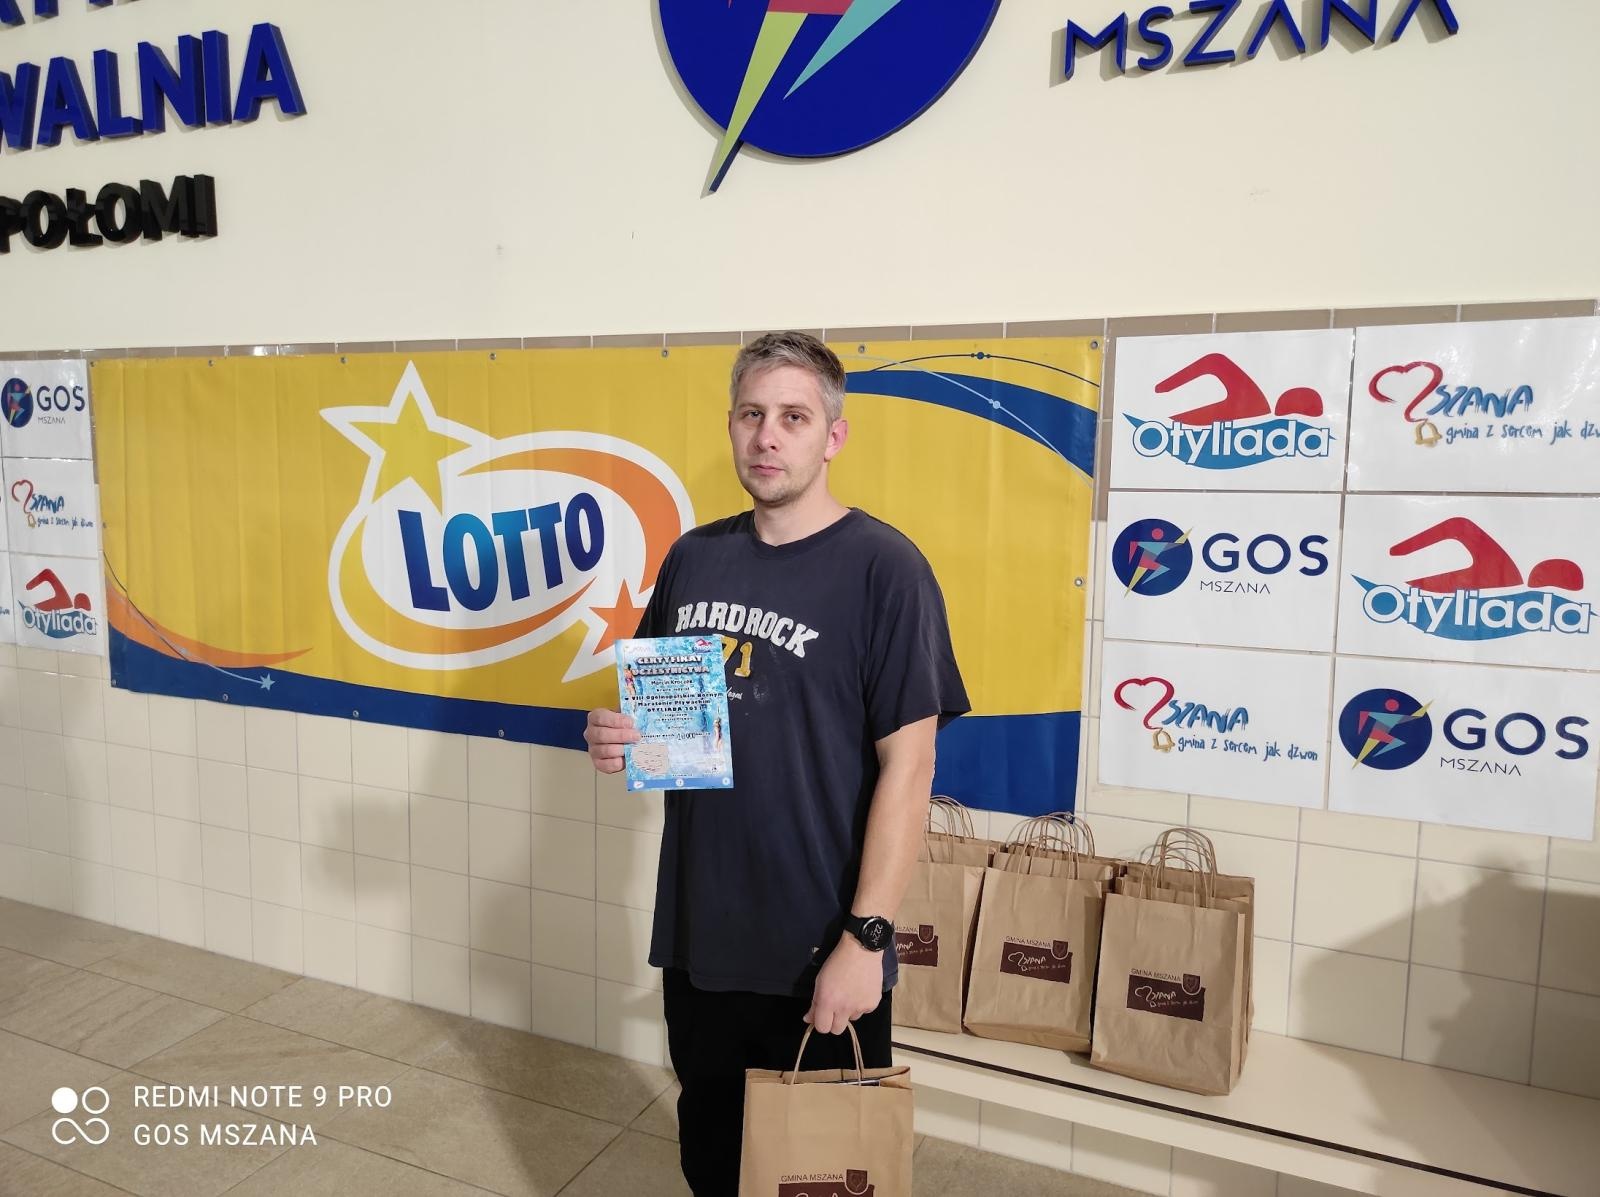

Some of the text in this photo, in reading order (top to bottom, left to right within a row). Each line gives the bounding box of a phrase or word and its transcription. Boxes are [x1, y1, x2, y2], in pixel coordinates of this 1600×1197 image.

[1065, 0, 1457, 80] MSZANA
[36, 385, 86, 411] GOS
[1132, 420, 1330, 465] Otyliada
[1446, 423, 1479, 444] gmina
[1502, 424, 1543, 438] sercem
[1550, 420, 1573, 445] jak
[397, 492, 605, 612] LOTTO
[1202, 533, 1329, 576] GOS
[1200, 581, 1271, 594] MSZANA
[22, 607, 97, 635] Otyliada
[1363, 585, 1591, 634] Otyliada
[1178, 735, 1205, 752] gmina
[1224, 739, 1257, 754] sercem
[1263, 742, 1281, 761] jak
[1288, 744, 1318, 760] dzwon
[1443, 708, 1589, 760] GOS
[1440, 757, 1522, 776] MSZANA
[781, 1173, 844, 1183] GMINA MSZANA
